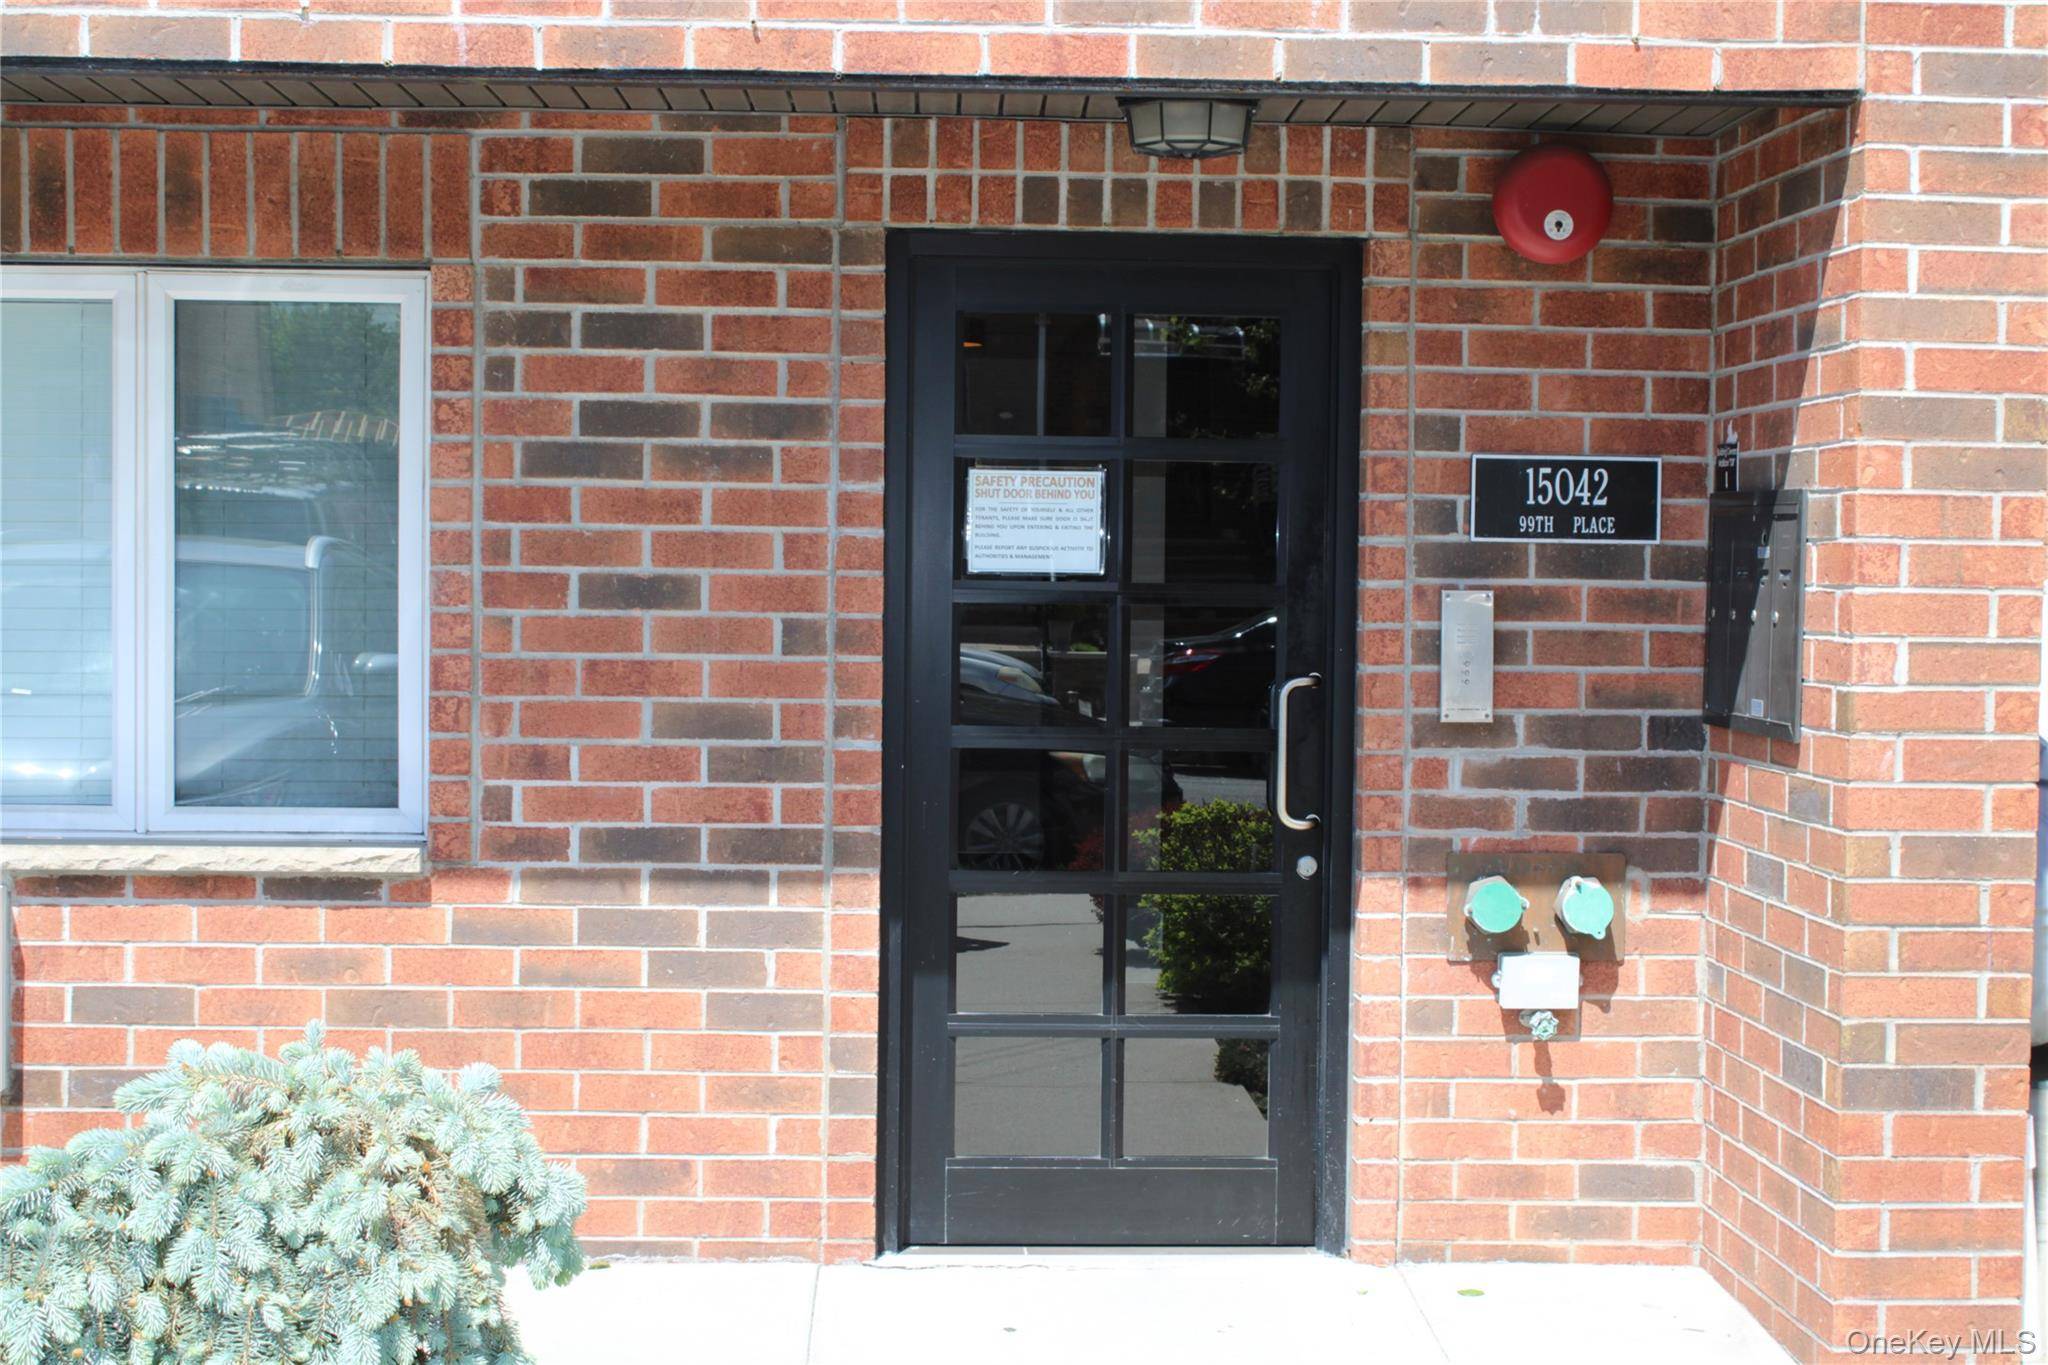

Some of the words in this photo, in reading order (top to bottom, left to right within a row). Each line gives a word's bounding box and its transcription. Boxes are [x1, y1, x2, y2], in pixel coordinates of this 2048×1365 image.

[975, 476, 1017, 486] SAFETY
[1021, 477, 1095, 488] PRECAUTION
[1526, 467, 1608, 506] 15042
[975, 488, 1000, 498] SHUT
[1004, 489, 1032, 498] DOOR
[1035, 489, 1071, 499] BEHIND
[1072, 490, 1095, 499] YOU
[1519, 516, 1554, 533] 99TH
[1573, 516, 1615, 534] PLACE
